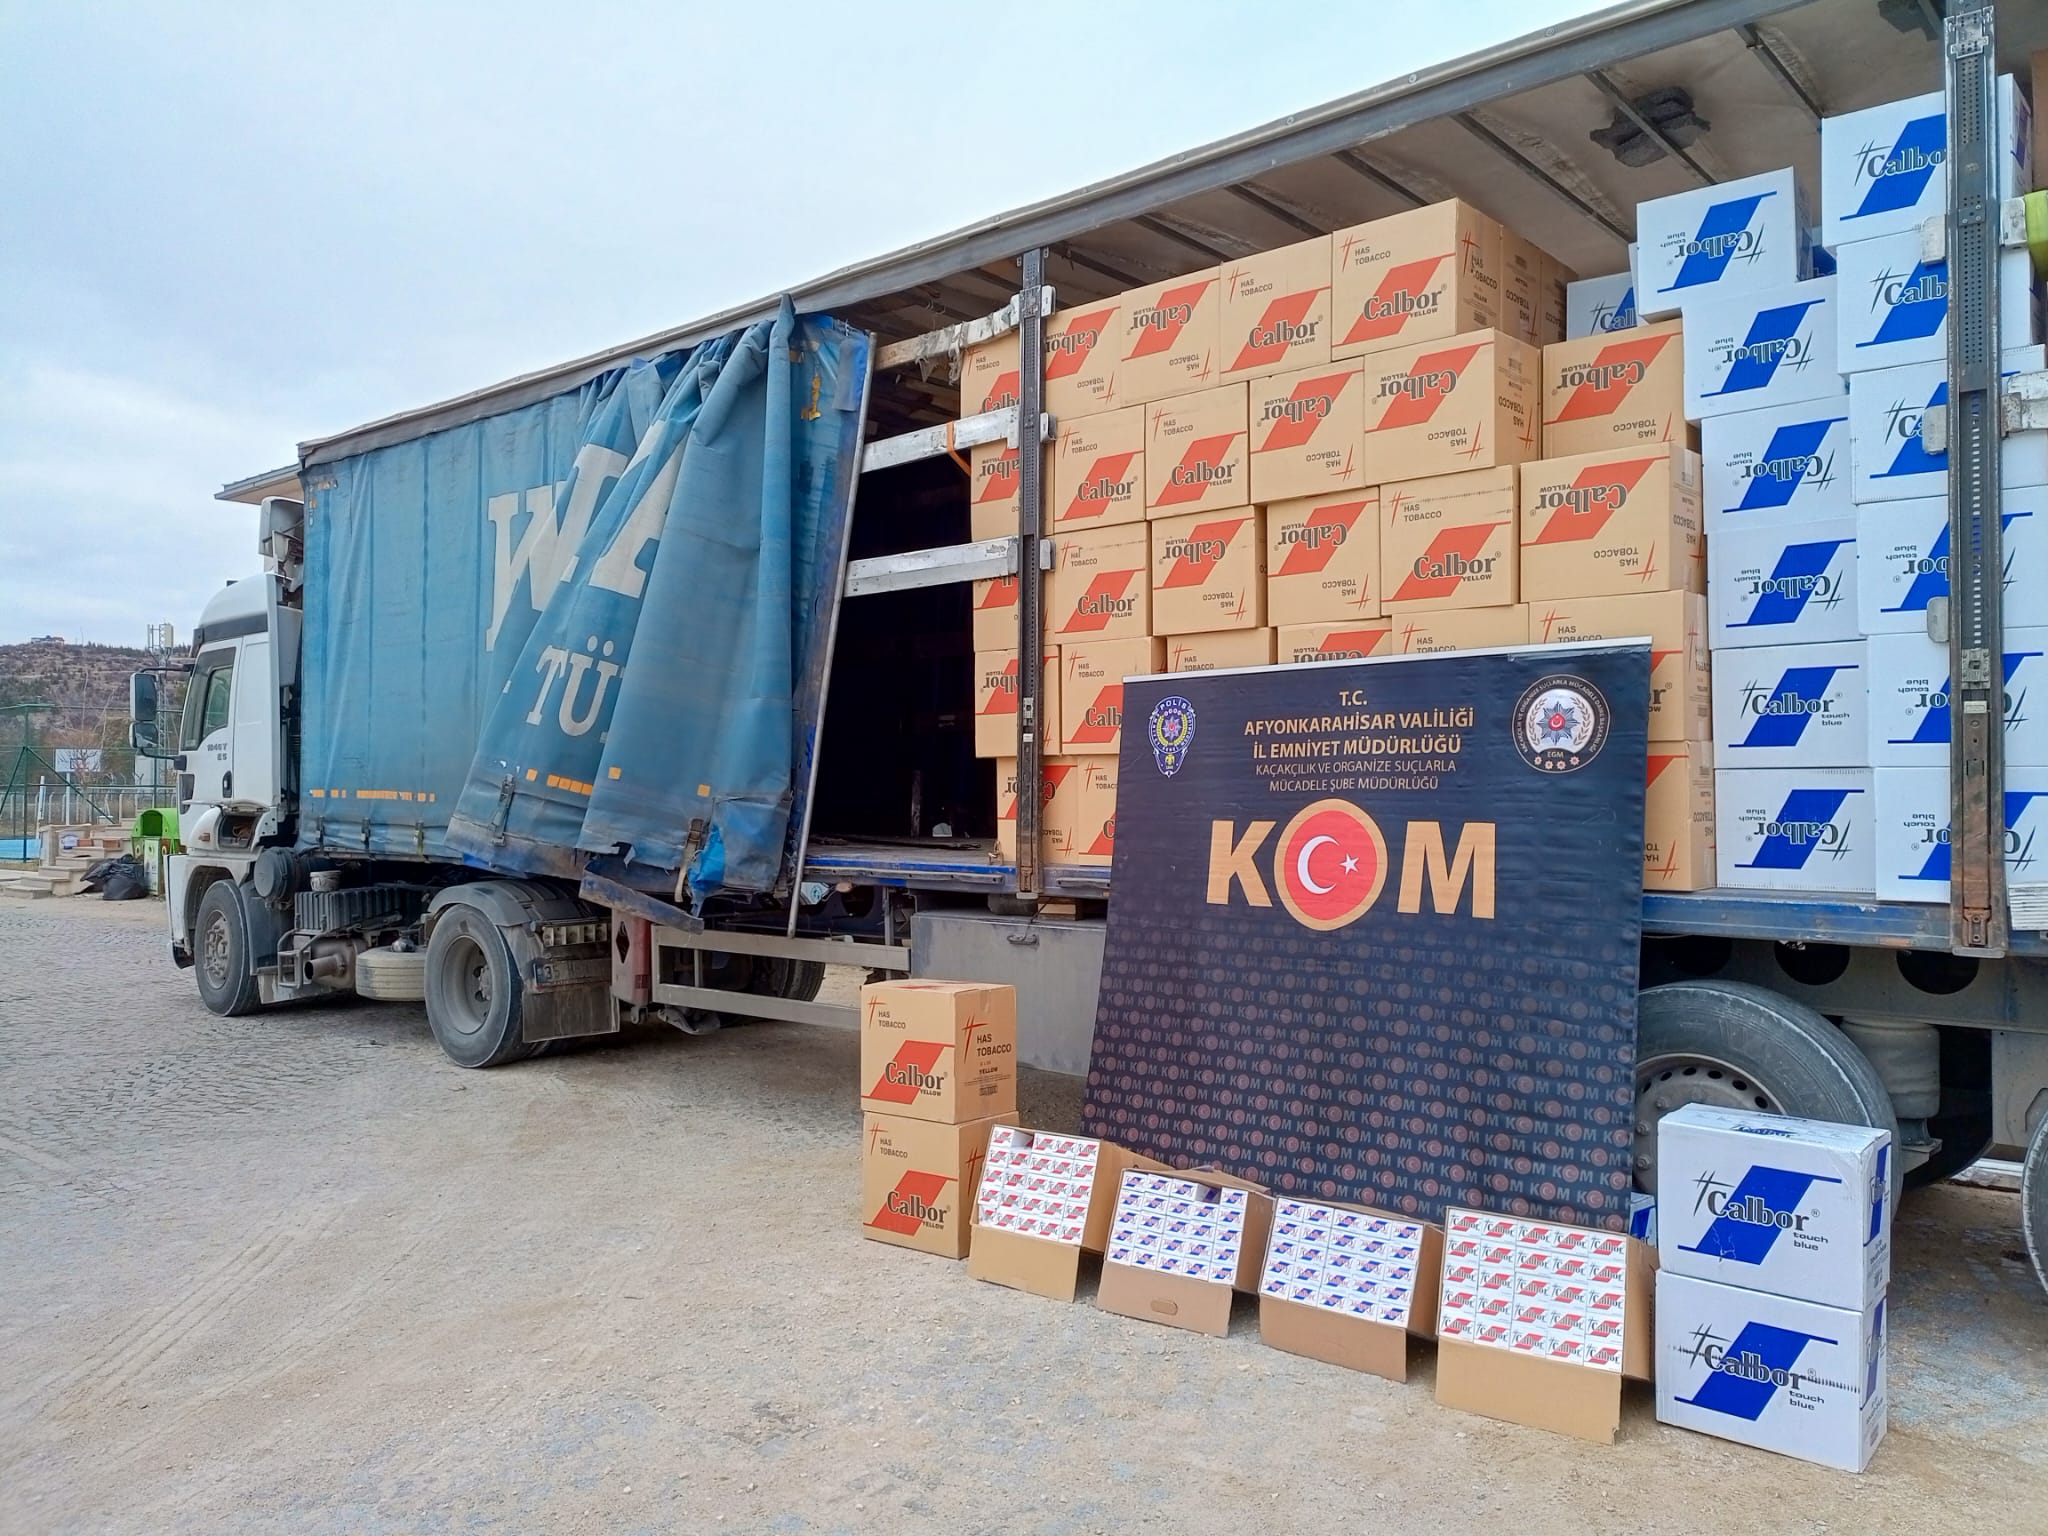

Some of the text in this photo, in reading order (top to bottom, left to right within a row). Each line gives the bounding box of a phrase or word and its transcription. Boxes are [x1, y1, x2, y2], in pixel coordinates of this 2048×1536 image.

[1867, 147, 1946, 178] Calbo
[1355, 246, 1370, 256] HAS
[1674, 232, 1755, 260] Calbor
[1355, 251, 1391, 266] TOBACCO
[1241, 278, 1255, 288] HAS
[1240, 282, 1273, 297] TOBACCO
[1884, 273, 1947, 307] Calb
[1363, 288, 1442, 322] Calbor
[1130, 304, 1191, 330] Calbor
[1410, 306, 1438, 318] YELLOW
[1249, 315, 1319, 349] Calbor
[1290, 336, 1316, 347] YELLOW
[1723, 337, 1802, 366] Calbor
[976, 356, 986, 364] HAS
[1169, 353, 1200, 366] TOBACCO
[976, 361, 999, 372] TOBACCO
[1187, 363, 1200, 371] HAS
[1561, 363, 1593, 374] YELLOW
[1381, 371, 1408, 383] YELLOW
[1557, 360, 1646, 390] Calbor
[1077, 377, 1104, 389] TOBACCO
[1377, 369, 1457, 400] Calbor
[1093, 386, 1104, 394] HAS
[1264, 396, 1289, 407] YELLOW
[1499, 396, 1524, 414] TOBACCO
[1259, 394, 1332, 423] Calbor
[1164, 419, 1176, 428] HAS
[1513, 415, 1524, 427] HAS
[1613, 418, 1656, 432] TOBACCO
[1164, 424, 1193, 435] TOBACCO
[1428, 428, 1467, 441] TOBACCO
[1638, 429, 1656, 439] HAS
[1071, 438, 1083, 446] HAS
[1450, 436, 1467, 447] HAS
[1071, 443, 1098, 454] TOBACCO
[1306, 450, 1341, 462] TOBACCO
[1733, 452, 1752, 460] blue
[1326, 459, 1341, 468] HAS
[1740, 454, 1823, 482] Calbor
[1171, 460, 1235, 486] Calbor
[1210, 478, 1232, 487] YELLOW
[1540, 483, 1572, 493] YELLOW
[1078, 478, 1134, 502] Calbor
[1535, 484, 1627, 514] Calbor
[1404, 503, 1420, 512] HAS
[1403, 511, 1442, 522] TOBACCO
[1277, 524, 1347, 549] Calbor
[1163, 539, 1226, 563] Calbor
[1593, 547, 1639, 559] TOBACCO
[1894, 544, 1917, 552] blue
[1071, 558, 1098, 567] TOBACCO
[1619, 557, 1639, 567] HAS
[1885, 552, 1917, 561] touch
[1413, 552, 1496, 580] Calbor
[1462, 573, 1492, 582] YELLOW
[1322, 580, 1356, 589] TOBACCO
[1749, 573, 1831, 600] Calbor
[1203, 592, 1234, 601] TOBACCO
[1078, 593, 1135, 615] Calbor
[1558, 625, 1577, 634] HAS
[1417, 637, 1433, 646] HAS
[1184, 663, 1214, 671] TOBACCO
[1079, 670, 1104, 678] TOBACCO
[1906, 678, 1929, 686] blue
[1339, 690, 1368, 706] T.C.
[1751, 691, 1835, 716] Calbor
[1244, 707, 1474, 736] AFYONKARAHİSAR VALİLİĞİ
[1253, 734, 1461, 759] İL EMNİYET MÜDÜRLÜĞÜ
[1256, 759, 1456, 776] KAÇAKÇILIK VE ORGANİZE SUÇLARLA
[1270, 776, 1439, 792] MÜCADELE ŞUBE MÜDÜRLÜĞÜ
[1753, 821, 1839, 846] Calbor
[878, 1010, 890, 1018] HAS
[878, 1020, 906, 1030] TOBACCO
[977, 1033, 992, 1043] HAS
[977, 1043, 1012, 1057] TOBACCO
[885, 1061, 944, 1091] Calbor
[979, 1067, 998, 1075] YELLOW
[880, 1138, 892, 1146] HAS
[880, 1148, 908, 1159] TOBACCO
[887, 1190, 947, 1224] Calbor
[1707, 1190, 1810, 1232] Calbor
[922, 1221, 944, 1230] YELLOW
[1793, 1231, 1828, 1244] touch
[1793, 1239, 1819, 1251] blue
[1704, 1342, 1813, 1391] Calbor
[1789, 1389, 1825, 1404] touch
[1789, 1398, 1815, 1411] blue
